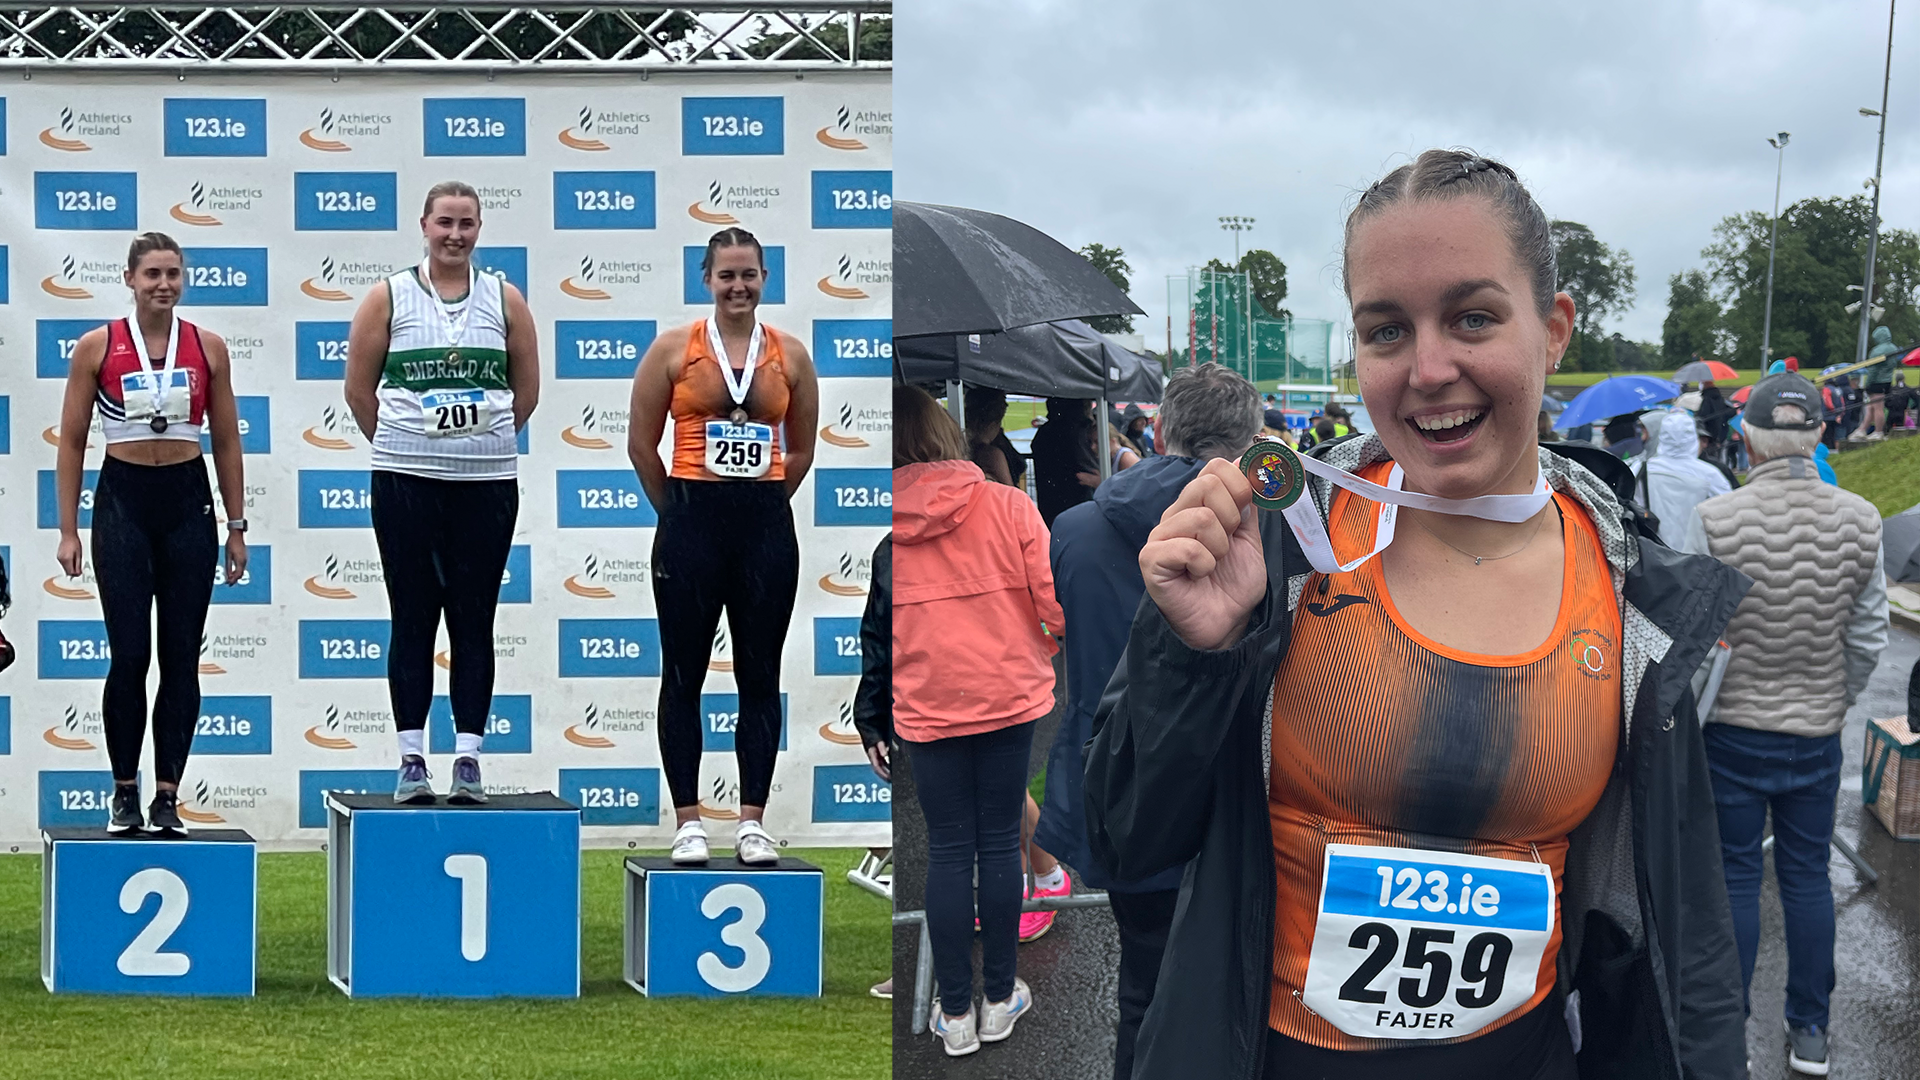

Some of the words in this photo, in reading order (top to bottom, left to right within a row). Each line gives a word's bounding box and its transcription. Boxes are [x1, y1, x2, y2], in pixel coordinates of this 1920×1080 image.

[79, 112, 132, 124] Athletics
[338, 113, 391, 124] Athletics
[597, 112, 650, 122] Athletics
[855, 111, 892, 122] Athlet
[79, 125, 120, 136] Ireland
[185, 118, 245, 137] 123.ie
[338, 125, 380, 136] Ireland
[445, 118, 505, 137] 123.ie
[598, 124, 638, 134] Ireland
[703, 116, 763, 136] 123.ie
[209, 187, 262, 198] Athletics
[478, 187, 521, 198] thletics
[727, 186, 780, 196] Athletics
[56, 191, 116, 211] 123.ie
[210, 200, 250, 210] Ireland
[316, 192, 376, 211] 123.ie
[480, 200, 510, 209] eland
[574, 190, 635, 210] 123.ie
[727, 198, 768, 208] Ireland
[832, 190, 892, 210] 123.ie
[80, 261, 127, 272] Athletic
[340, 263, 393, 273] Athletics
[599, 261, 651, 272] Athletics
[856, 260, 892, 271] Athlet
[81, 274, 121, 283] Ireland
[187, 267, 247, 287] 123.ie
[340, 275, 381, 285] Ireland
[599, 273, 640, 283] Ireland
[227, 337, 263, 347] hletics
[317, 341, 350, 360] 123
[576, 340, 636, 360] 123.ie
[834, 339, 892, 358] 123.ie
[402, 360, 478, 381] EMERALD
[480, 360, 498, 380] AC
[436, 403, 478, 430] 201
[857, 409, 892, 419] Athlet
[601, 423, 625, 433] Irela
[715, 440, 762, 467] 259
[578, 489, 638, 508] 123.ie
[835, 488, 892, 507] 123.ie
[344, 560, 381, 571] Athlet
[603, 560, 650, 569] Athletic
[603, 572, 644, 582] Ireland
[213, 636, 266, 646] Athletics
[495, 635, 527, 645] letics
[213, 648, 255, 658] Ireland
[320, 640, 380, 659] 123.ie
[580, 638, 640, 658] 123.ie
[344, 711, 390, 721] Athletic
[603, 709, 655, 720] Athletics
[344, 723, 385, 733] Ireland
[603, 721, 644, 731] Ireland
[708, 713, 738, 733] 123
[214, 786, 267, 797] Athletics
[833, 784, 891, 803] 123.ie
[214, 798, 255, 808] Ireland
[580, 788, 639, 807] 123.ie
[1376, 866, 1500, 916] 123.ie
[444, 854, 488, 962] 1
[116, 867, 190, 976] 2
[697, 883, 771, 993] 3
[1338, 922, 1513, 1009] 259
[1376, 1010, 1455, 1029] FAJER
